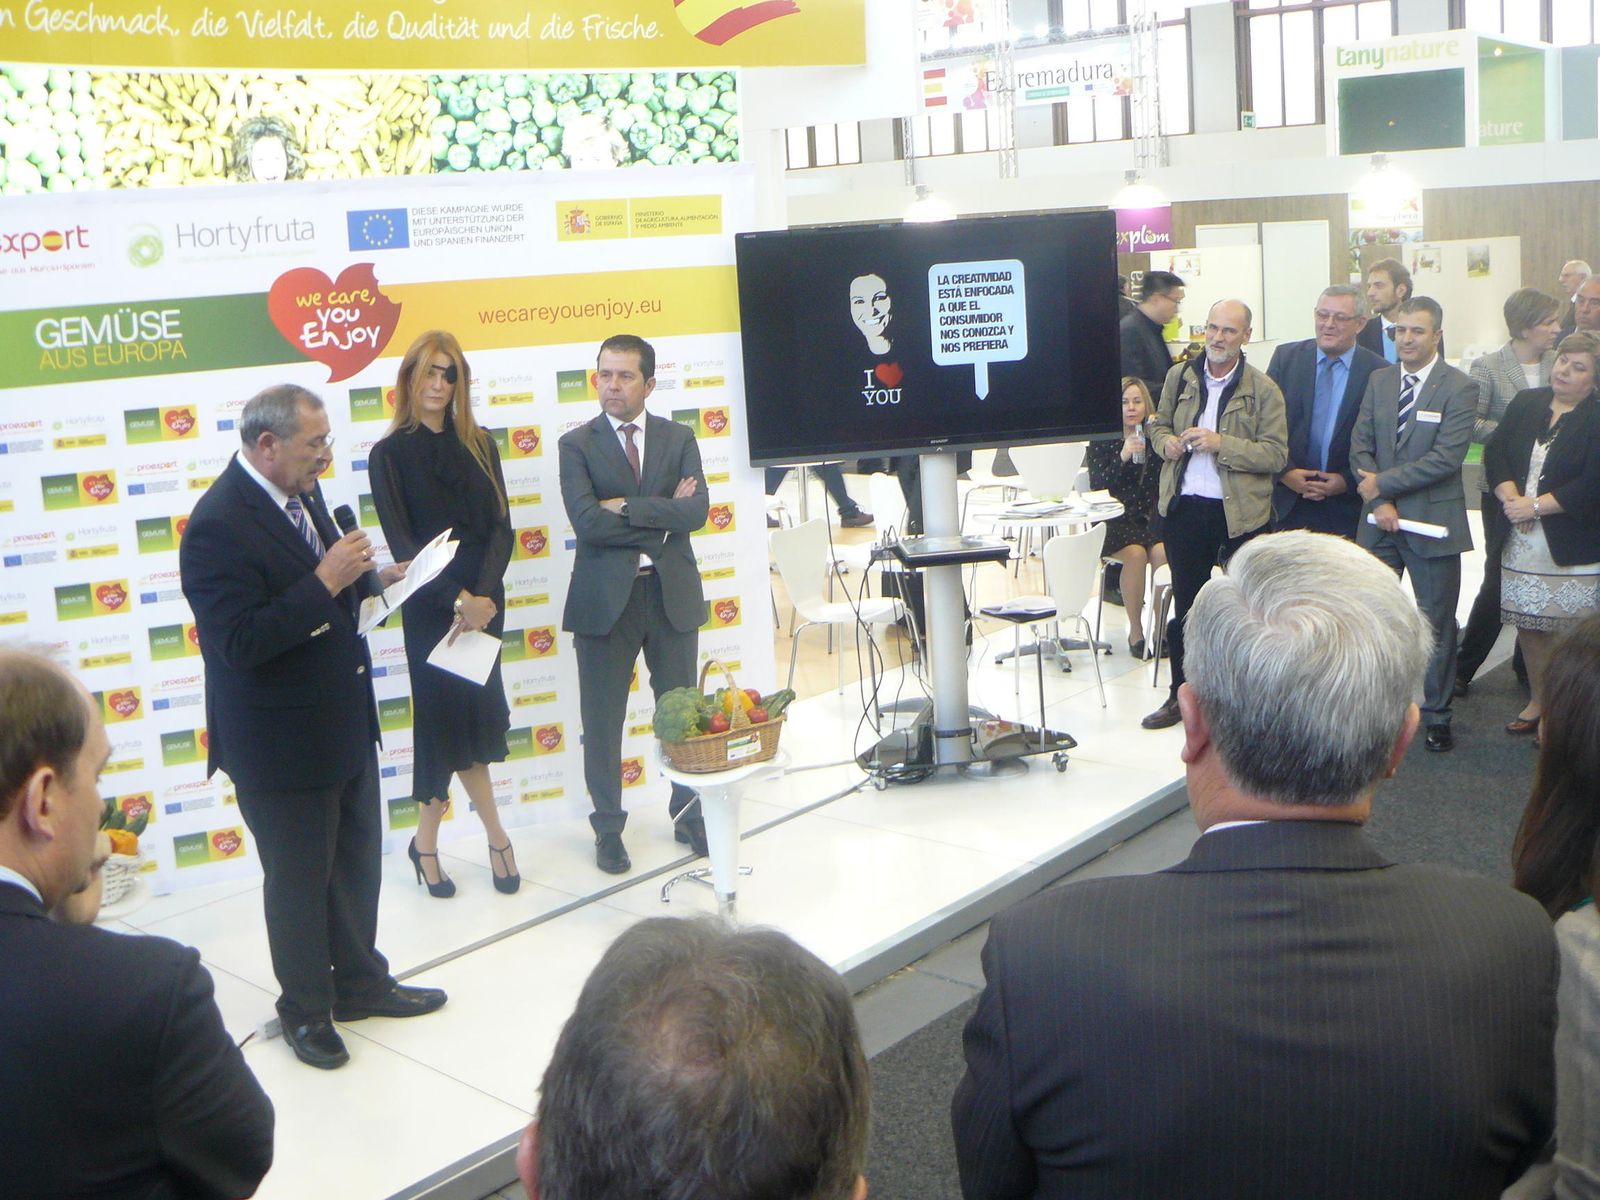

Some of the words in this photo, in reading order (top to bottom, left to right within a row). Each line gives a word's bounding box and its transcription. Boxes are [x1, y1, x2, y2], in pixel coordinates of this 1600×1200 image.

[191, 8, 229, 37] die
[343, 12, 380, 39] die
[387, 11, 480, 40] Qualität
[488, 13, 532, 40] und
[540, 13, 575, 40] die
[411, 207, 438, 216] DIESE
[440, 205, 489, 214] KAMPAGNE
[491, 203, 524, 212] WURDE
[507, 213, 525, 222] DER
[176, 216, 315, 253] Hortyfruta
[485, 224, 512, 233] UNION
[414, 238, 433, 247] UND
[435, 236, 473, 245] SPANIEN
[475, 234, 525, 244] FINANZIERT
[937, 275, 949, 286] LA
[951, 271, 1012, 285] CREATIVIDAD
[938, 286, 962, 299] ESTÁ
[964, 284, 1014, 298] ENFOCADA
[295, 292, 322, 307] we
[938, 303, 946, 313] A
[947, 302, 967, 312] QUE
[969, 300, 981, 311] EL
[316, 307, 360, 330] you
[478, 298, 662, 324] wecareyouenjoy.eu
[939, 312, 1003, 326] CONSUMIDOR
[35, 307, 183, 349] GEMÜSE
[299, 321, 381, 350] Enjoy
[940, 328, 960, 340] NOS
[962, 326, 1006, 338] CONOZCA
[1007, 324, 1014, 335] Y
[941, 341, 961, 353] NOS
[962, 339, 1009, 352] PREFIERA
[39, 347, 88, 371] AUS
[93, 339, 188, 367] EUROPA
[864, 369, 875, 388] I
[861, 388, 902, 406] YOU
